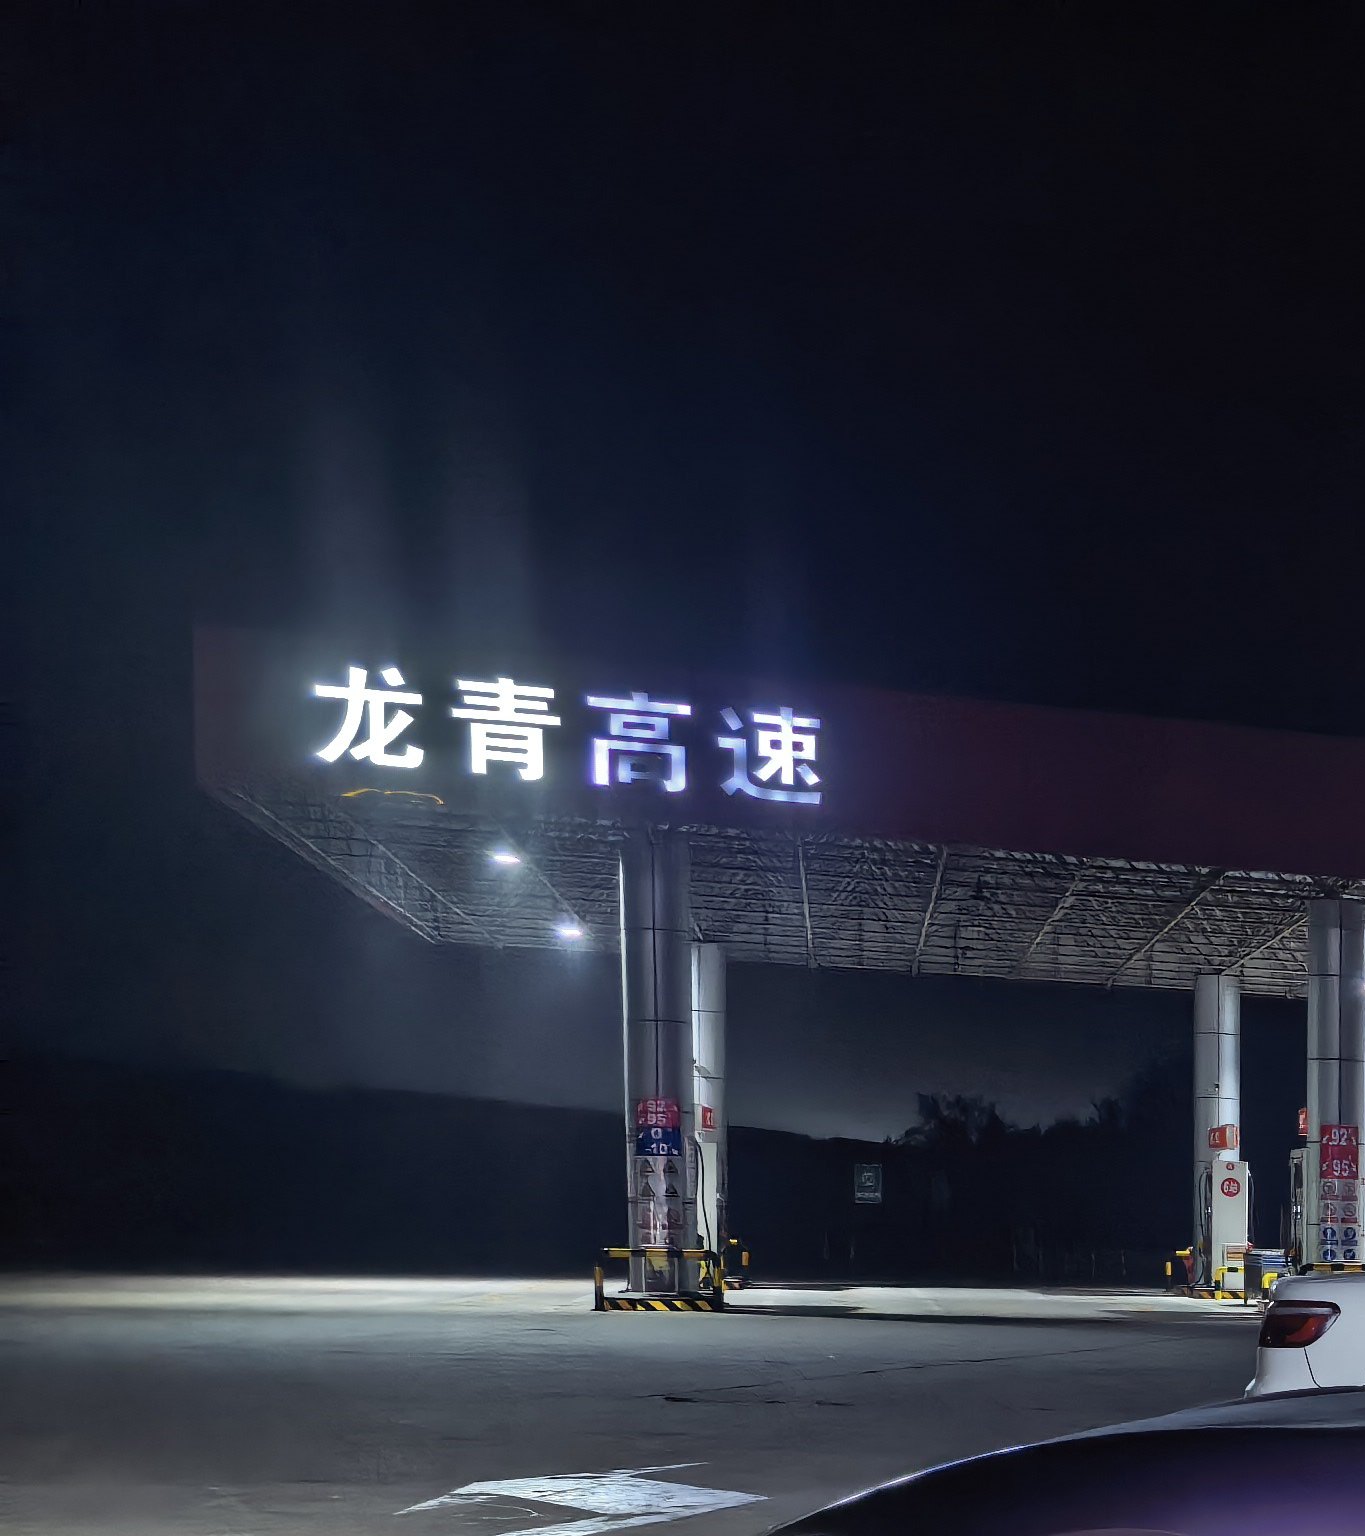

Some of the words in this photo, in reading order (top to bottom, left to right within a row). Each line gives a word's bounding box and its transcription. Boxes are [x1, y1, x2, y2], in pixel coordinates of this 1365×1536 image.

[312, 665, 823, 806] 龙青高速
[647, 1113, 667, 1125] 95
[1329, 1128, 1349, 1146] 92
[1332, 1159, 1350, 1177] 95
